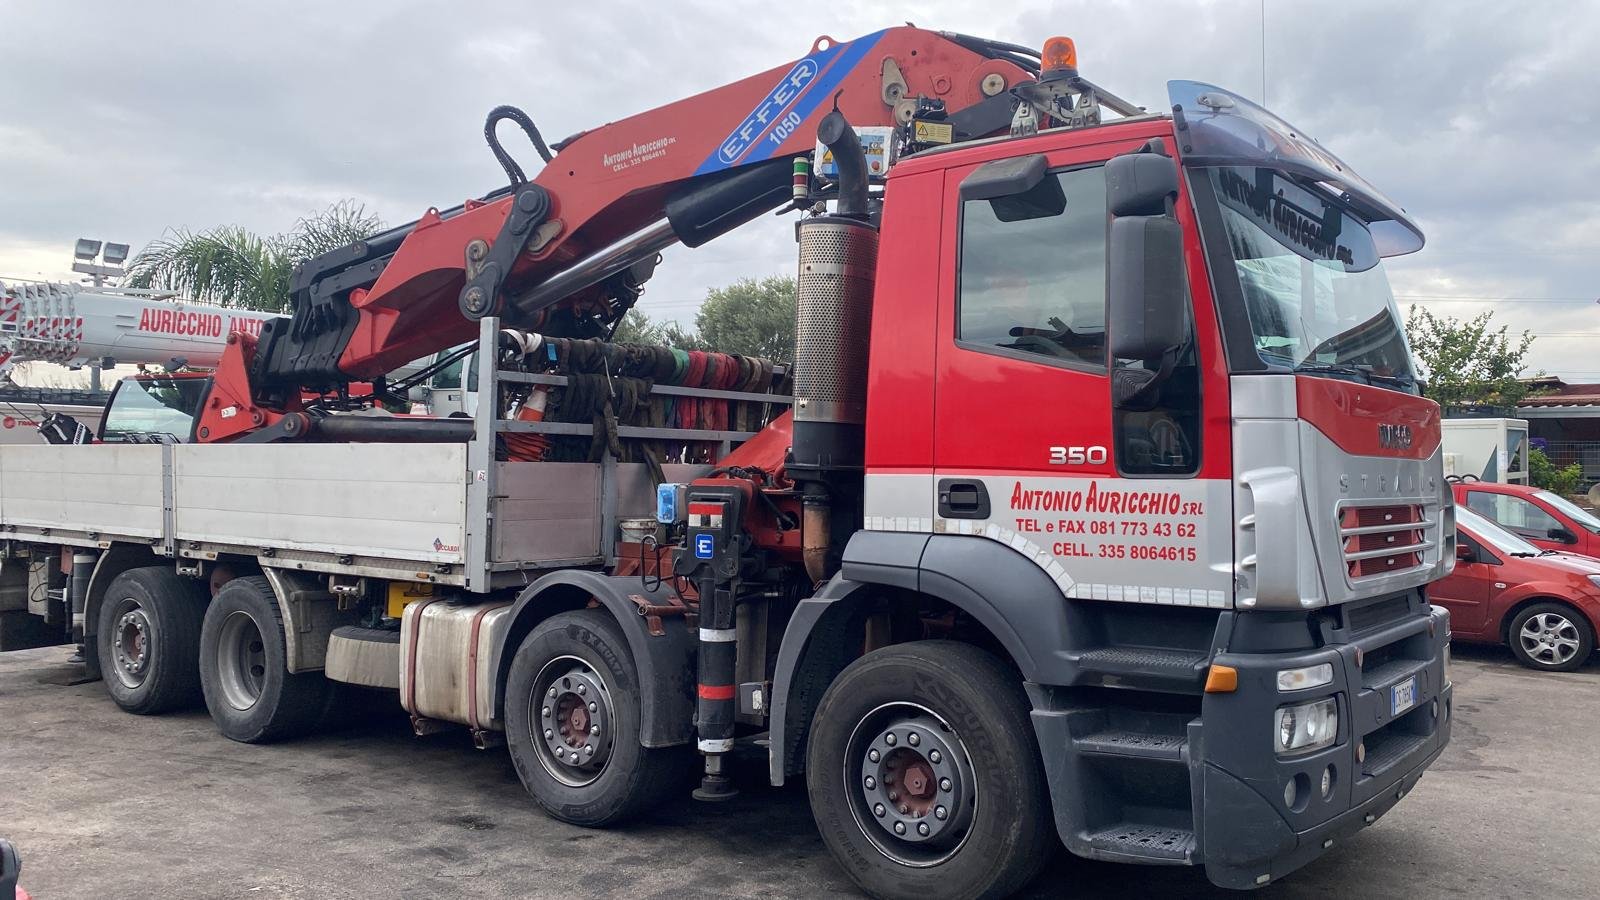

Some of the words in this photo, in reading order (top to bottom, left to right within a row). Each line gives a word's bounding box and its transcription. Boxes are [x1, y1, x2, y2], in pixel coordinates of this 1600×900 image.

[721, 65, 813, 159] EFFER
[770, 111, 801, 145] 1050
[603, 150, 632, 167] ANTONIO
[633, 137, 668, 157] AURICCHIO
[613, 161, 630, 172] CELL.
[138, 307, 222, 338] AURICCHIO
[1049, 446, 1107, 465] 350
[1011, 481, 1082, 513] ANTONIO
[1085, 480, 1181, 515] AURICCHIO
[1181, 502, 1204, 515] SRL
[1016, 518, 1042, 533] TEL
[1046, 523, 1054, 533] e
[1058, 519, 1086, 534] FAX
[1090, 520, 1115, 535] 081
[1121, 521, 1148, 536] 773
[1153, 522, 1172, 537] 43
[1177, 523, 1196, 537] 62
[697, 539, 712, 554] E
[1053, 542, 1094, 557] CELL.
[1098, 544, 1125, 558] 335
[1130, 545, 1196, 561] 8064615
